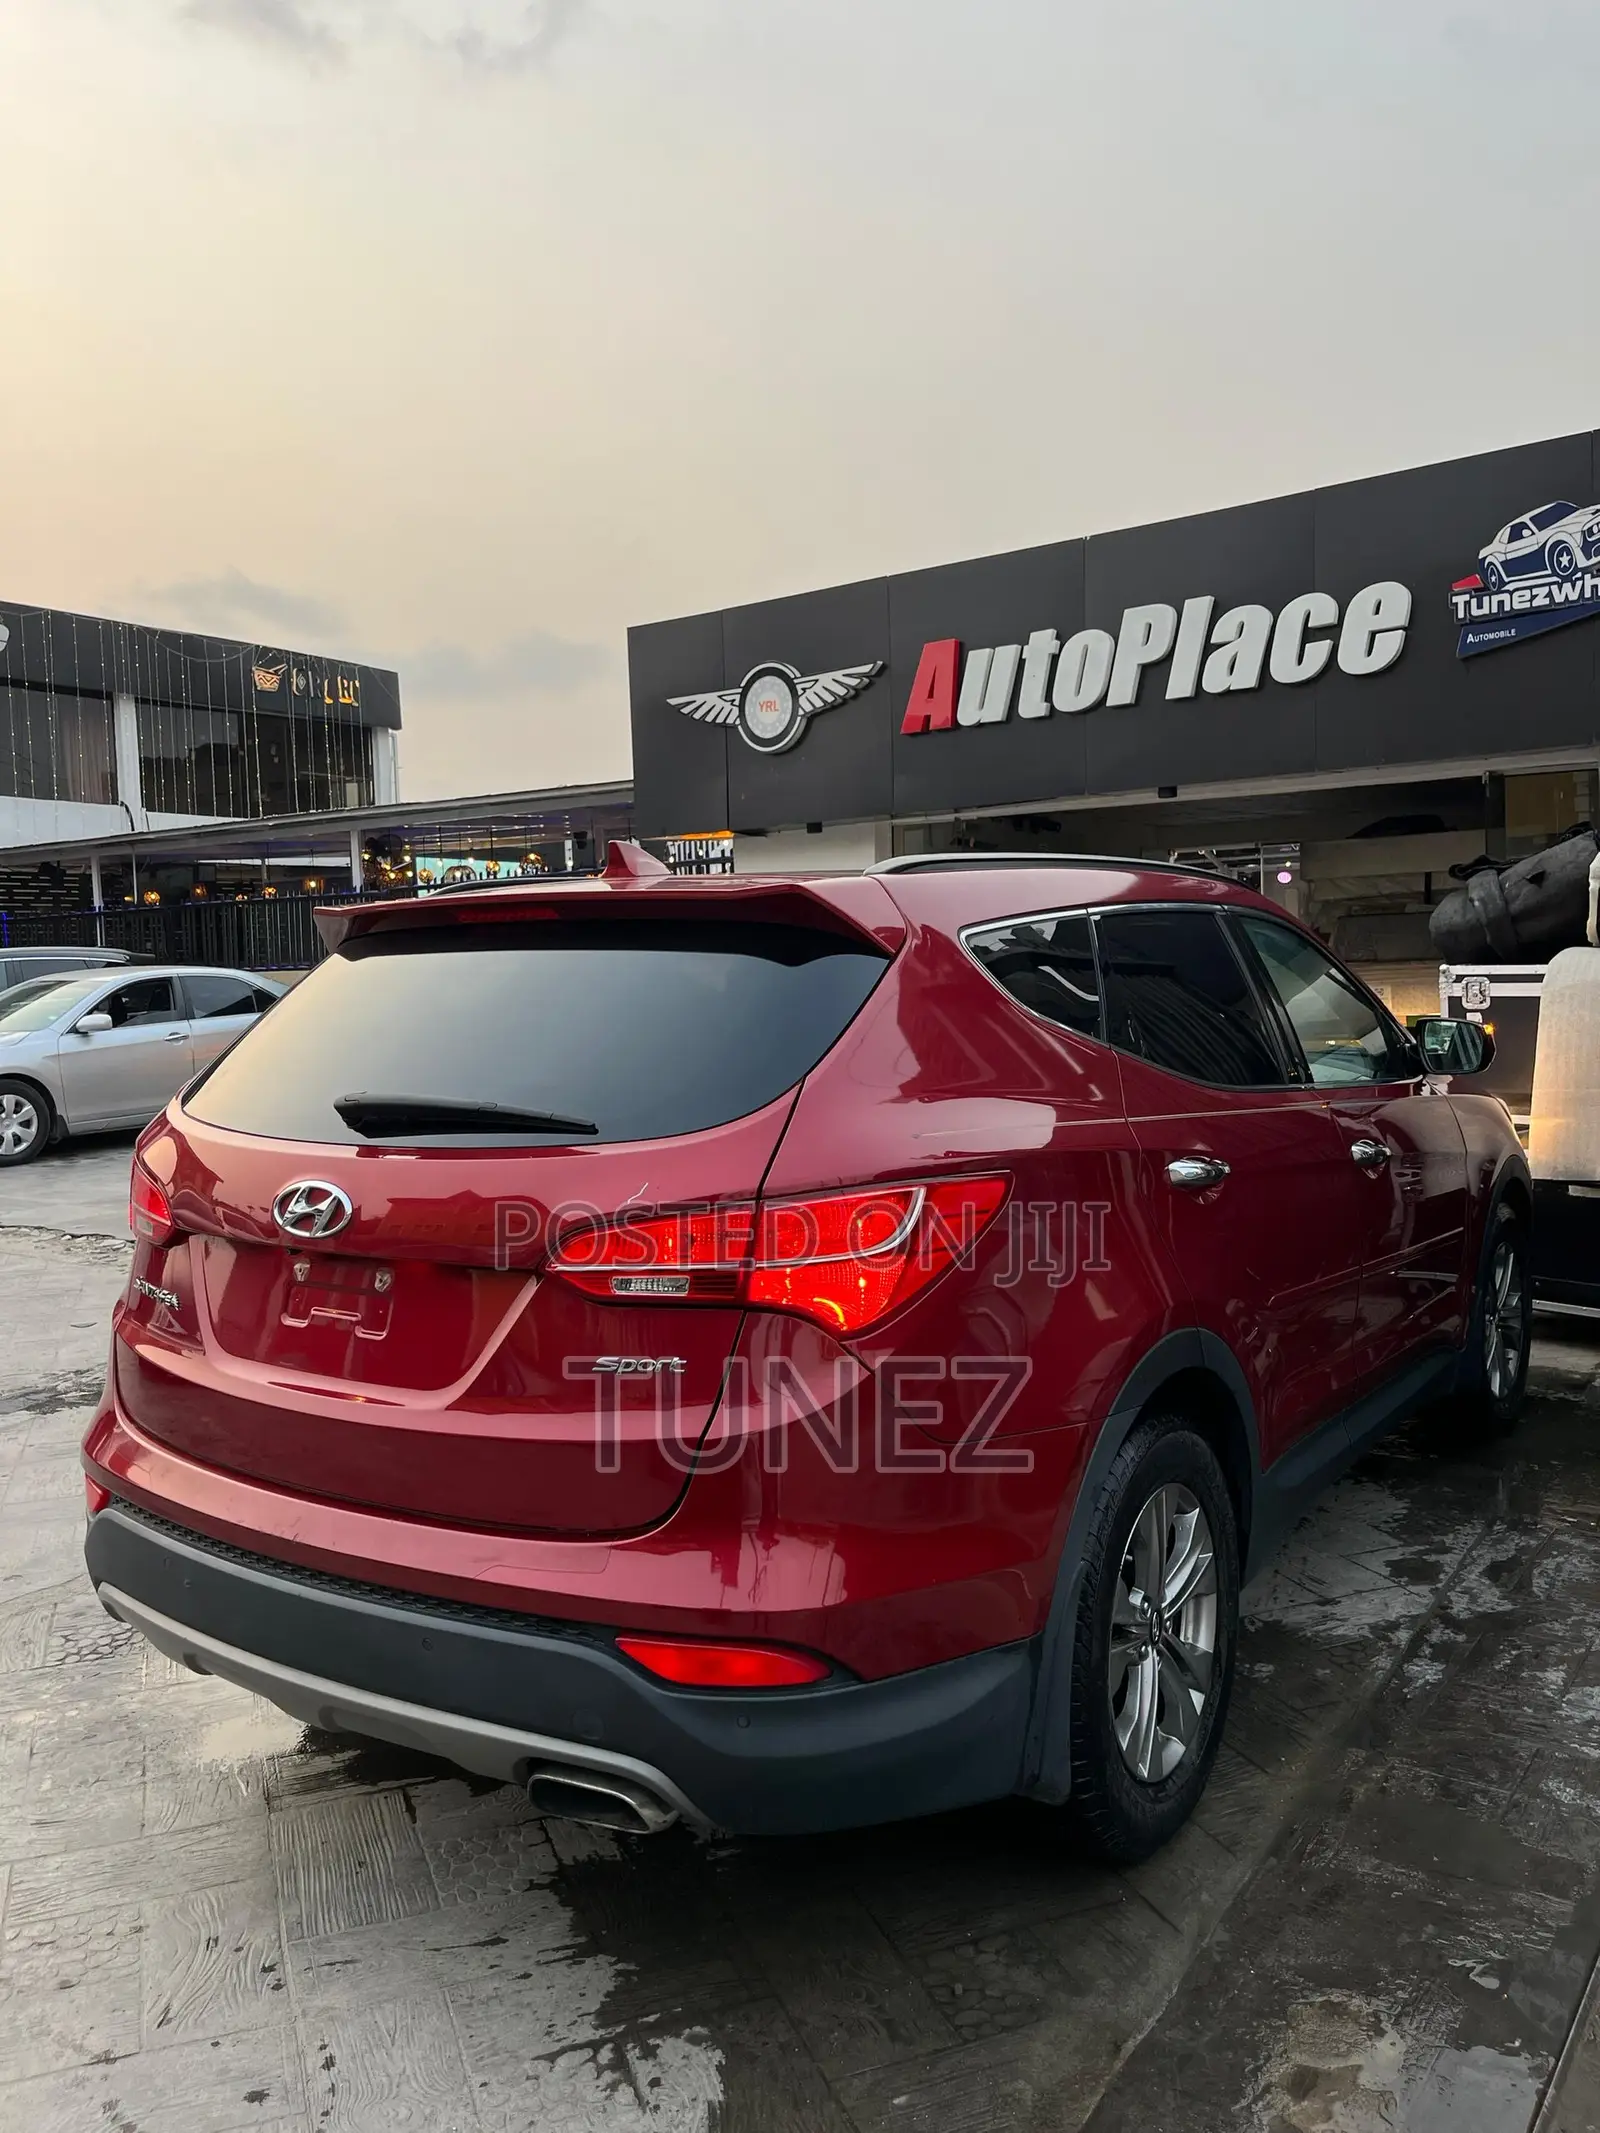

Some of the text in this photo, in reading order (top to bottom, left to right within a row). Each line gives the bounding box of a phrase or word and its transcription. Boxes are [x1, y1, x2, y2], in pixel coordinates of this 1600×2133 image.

[1466, 628, 1516, 644] AUTOMOBILE
[900, 581, 1413, 734] AutoPlace
[758, 700, 780, 713] YRL
[591, 1356, 687, 1376] Sport
